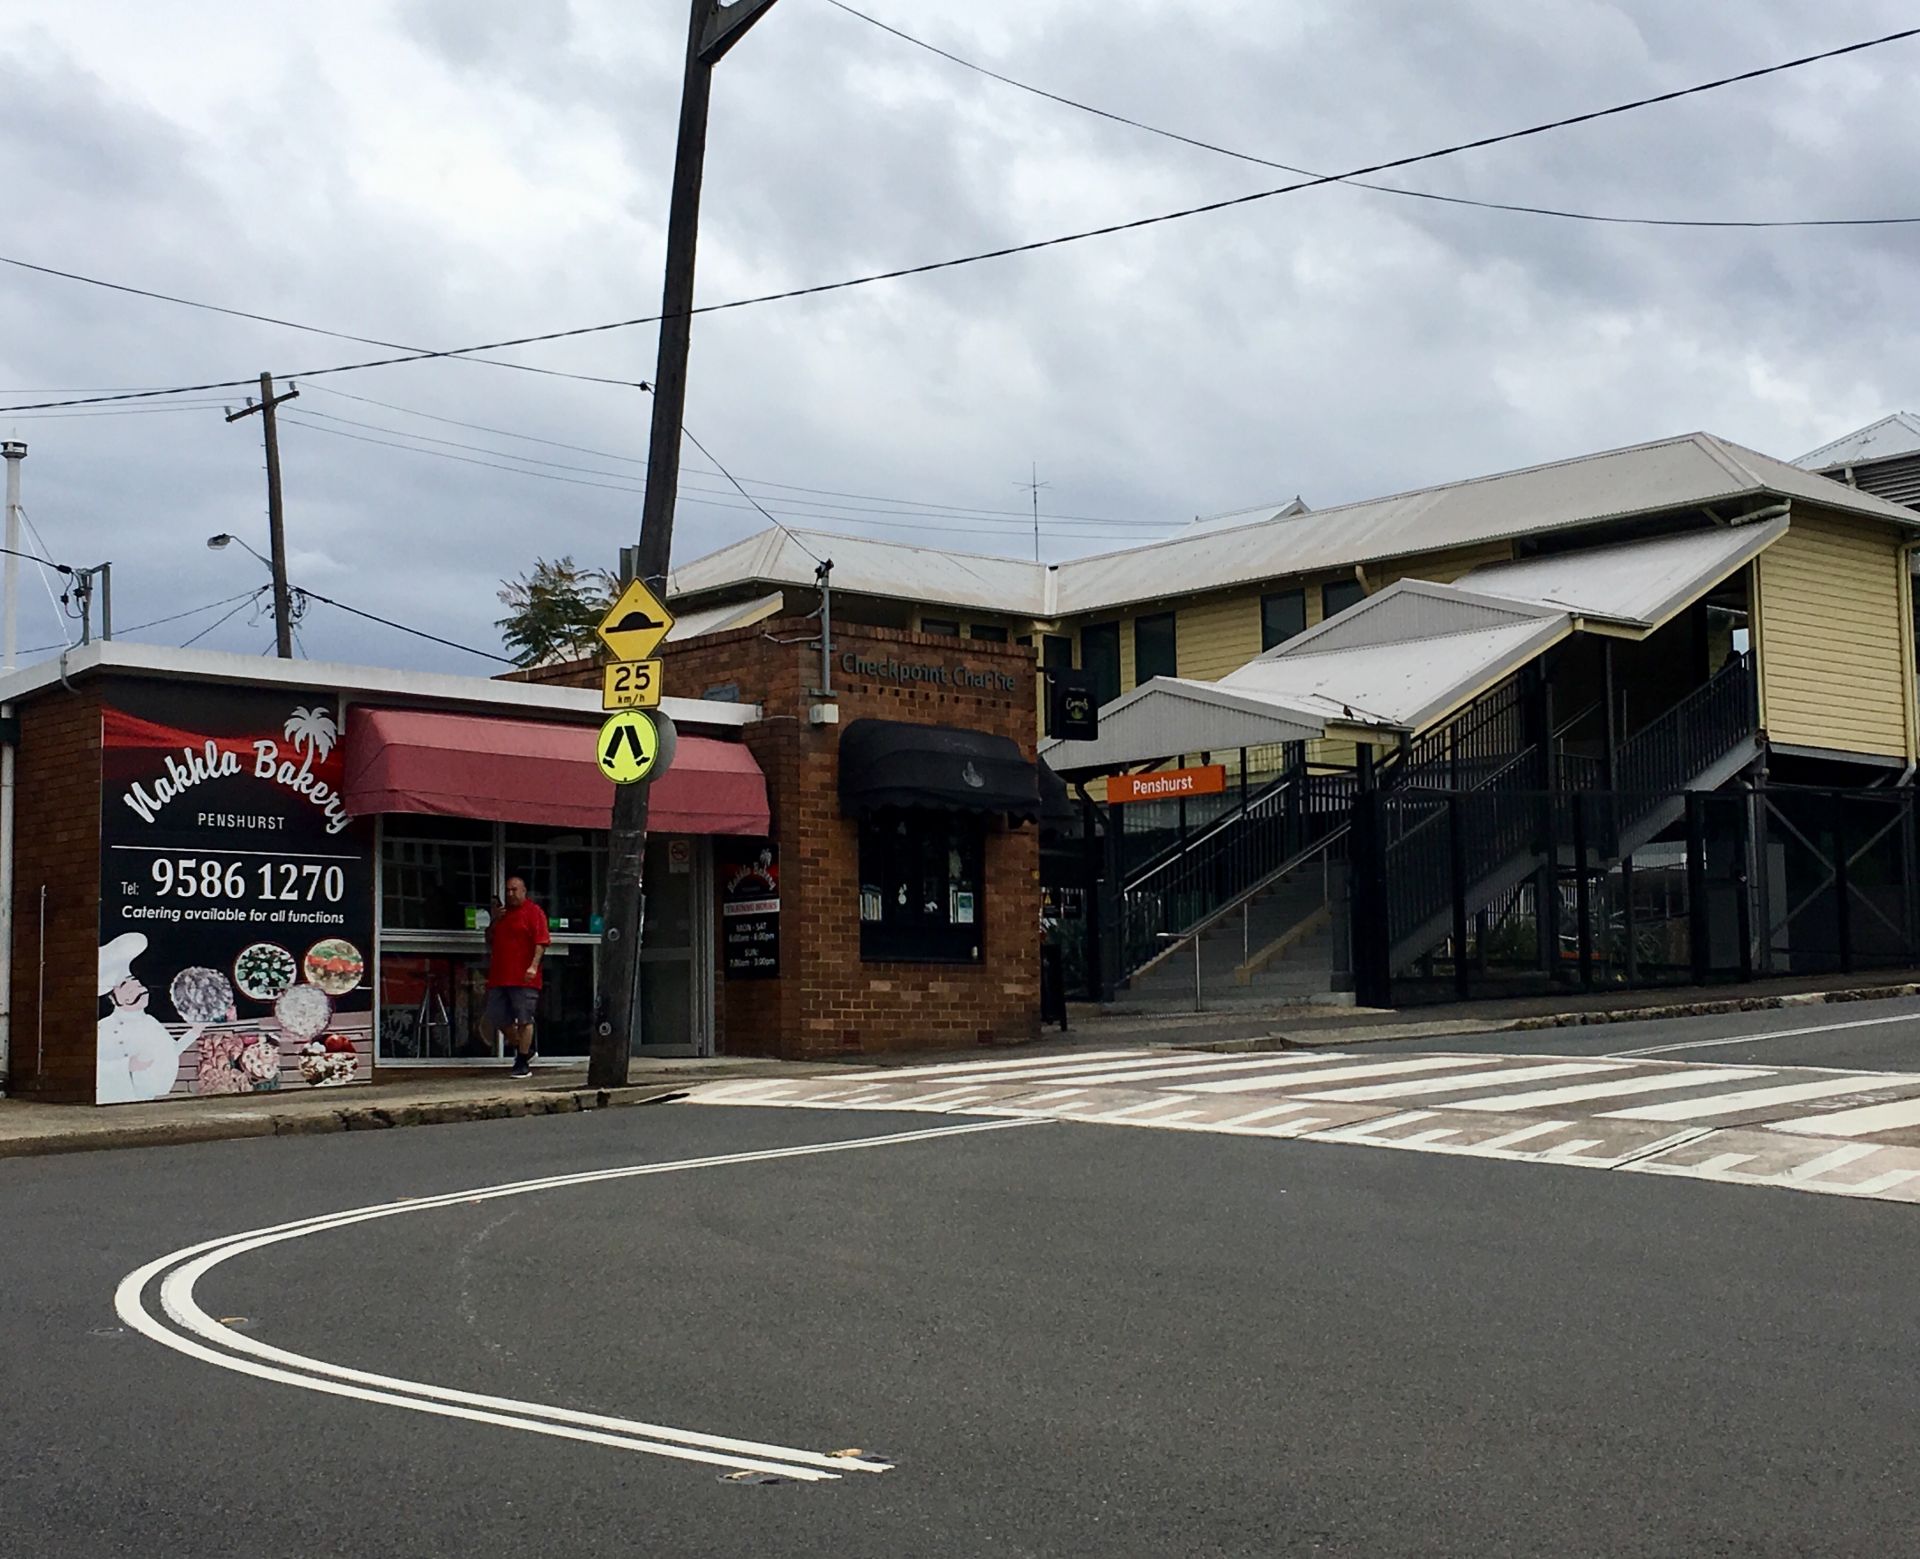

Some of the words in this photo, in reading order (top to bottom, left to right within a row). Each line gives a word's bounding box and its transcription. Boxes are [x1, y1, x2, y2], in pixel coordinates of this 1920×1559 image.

[614, 665, 650, 691] 25
[841, 652, 947, 684] Checkpoint
[952, 666, 1016, 691] Charlie
[617, 693, 645, 706] km/h
[123, 740, 242, 824] Nakhla
[252, 739, 353, 834] Bakery
[1132, 775, 1193, 795] Penshurst
[197, 812, 285, 830] PENSHURST
[120, 881, 140, 896] Tel:
[151, 858, 246, 899] 9586
[257, 862, 345, 902] 1270
[121, 905, 181, 922] Catering
[184, 907, 247, 921] available
[249, 908, 267, 922] for
[270, 909, 286, 922] all
[288, 910, 344, 924] functions
